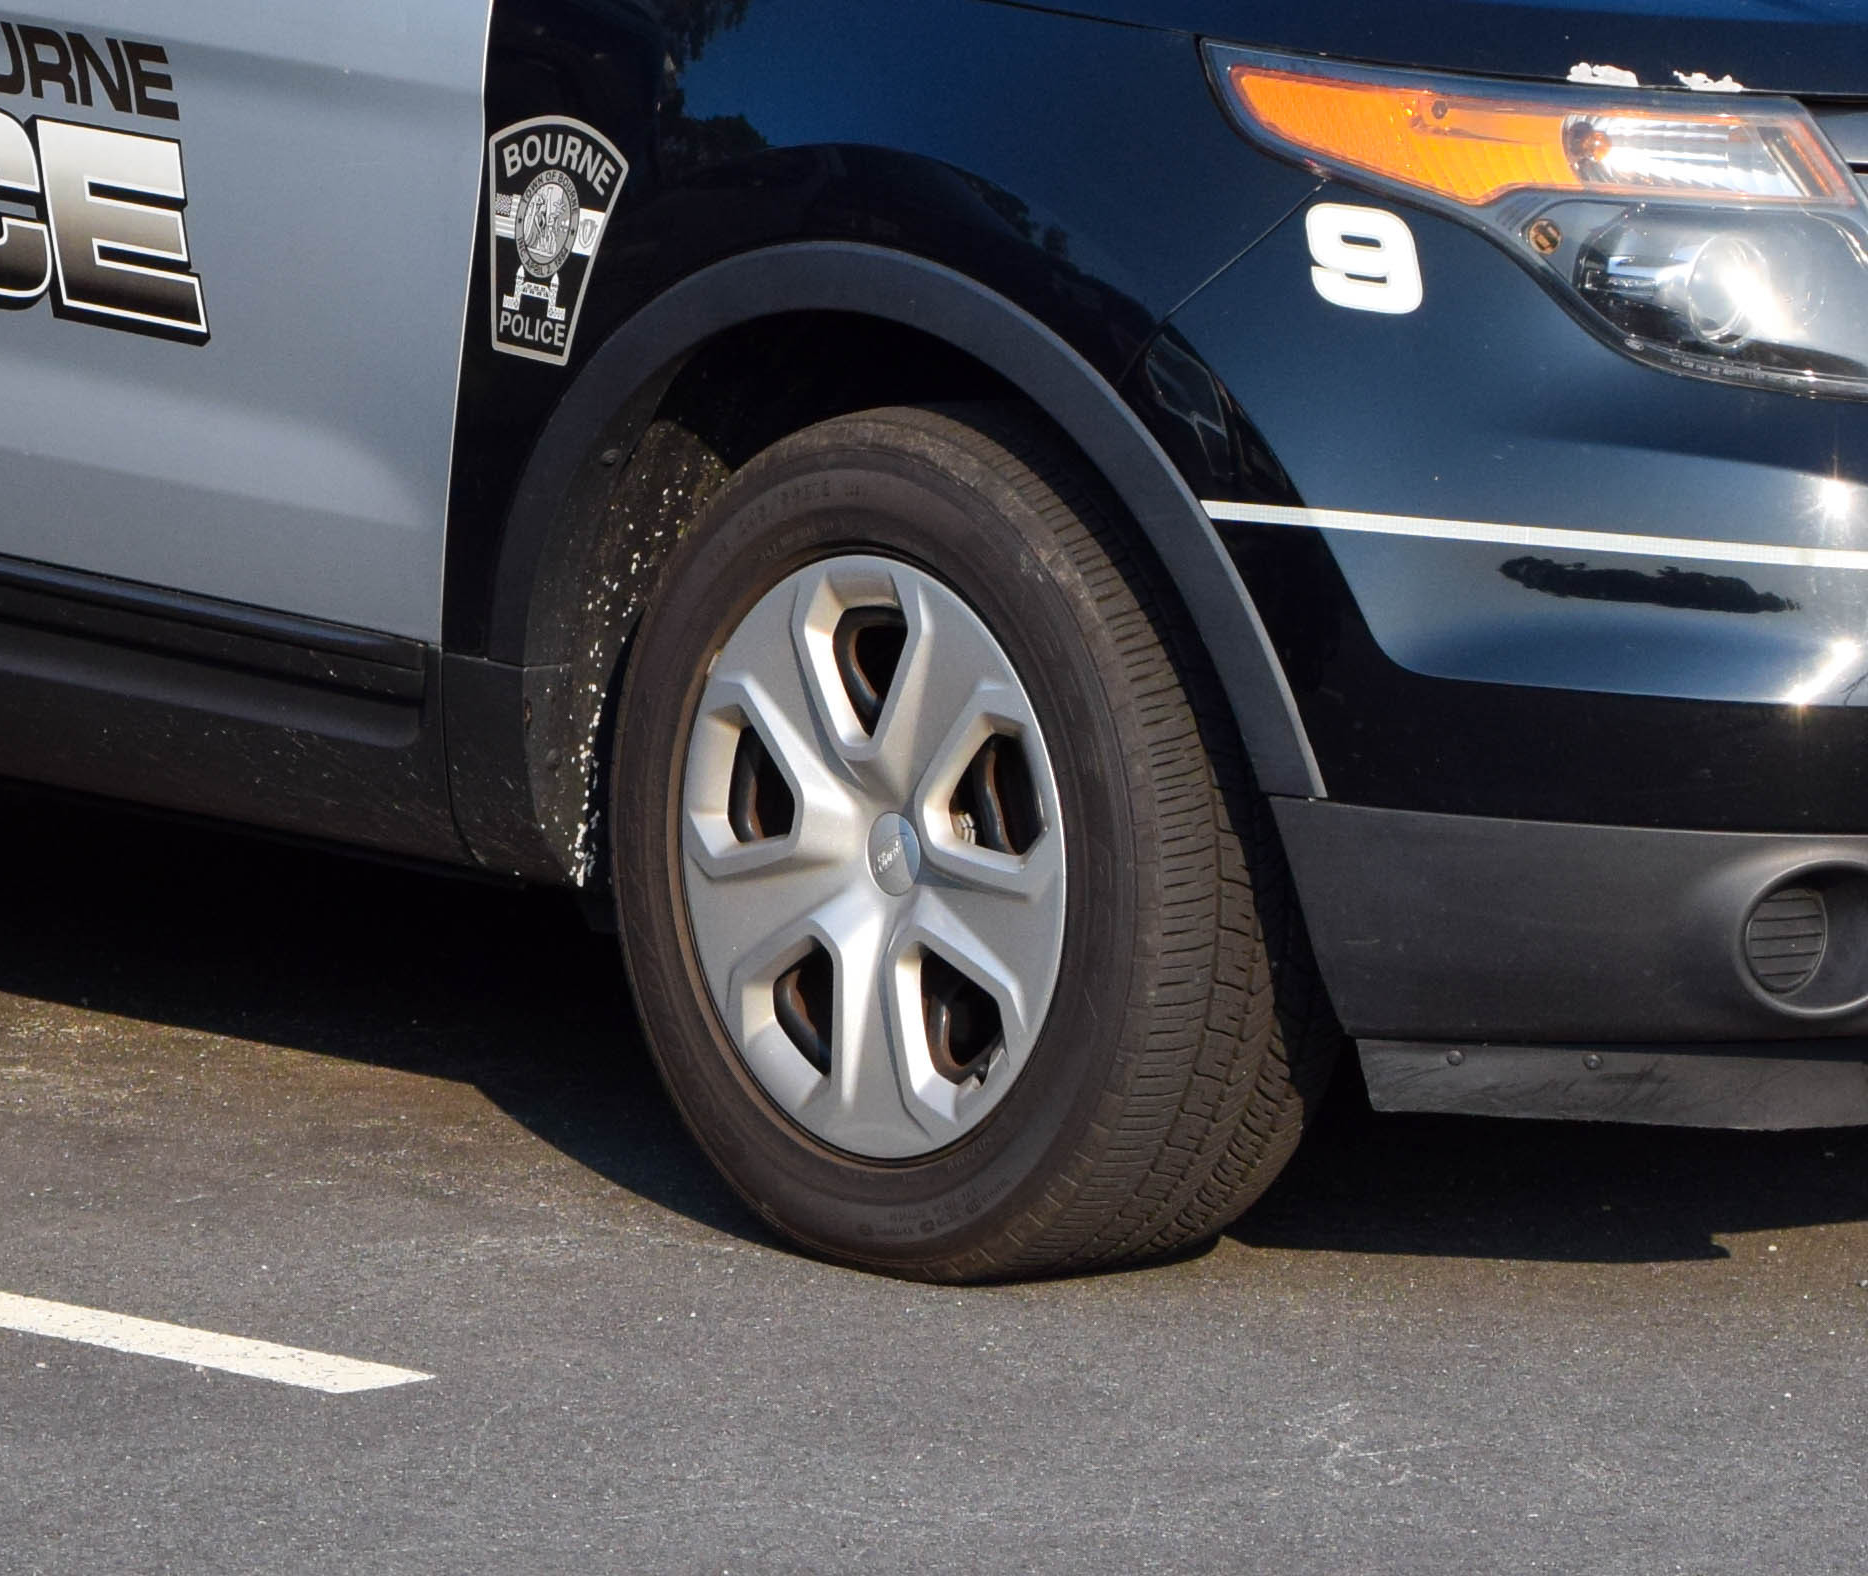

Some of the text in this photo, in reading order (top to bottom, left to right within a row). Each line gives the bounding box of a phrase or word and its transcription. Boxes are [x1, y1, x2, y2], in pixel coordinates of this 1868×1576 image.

[502, 133, 616, 196] BOURNE
[1305, 202, 1423, 314] 9
[499, 311, 566, 347] POLICE
